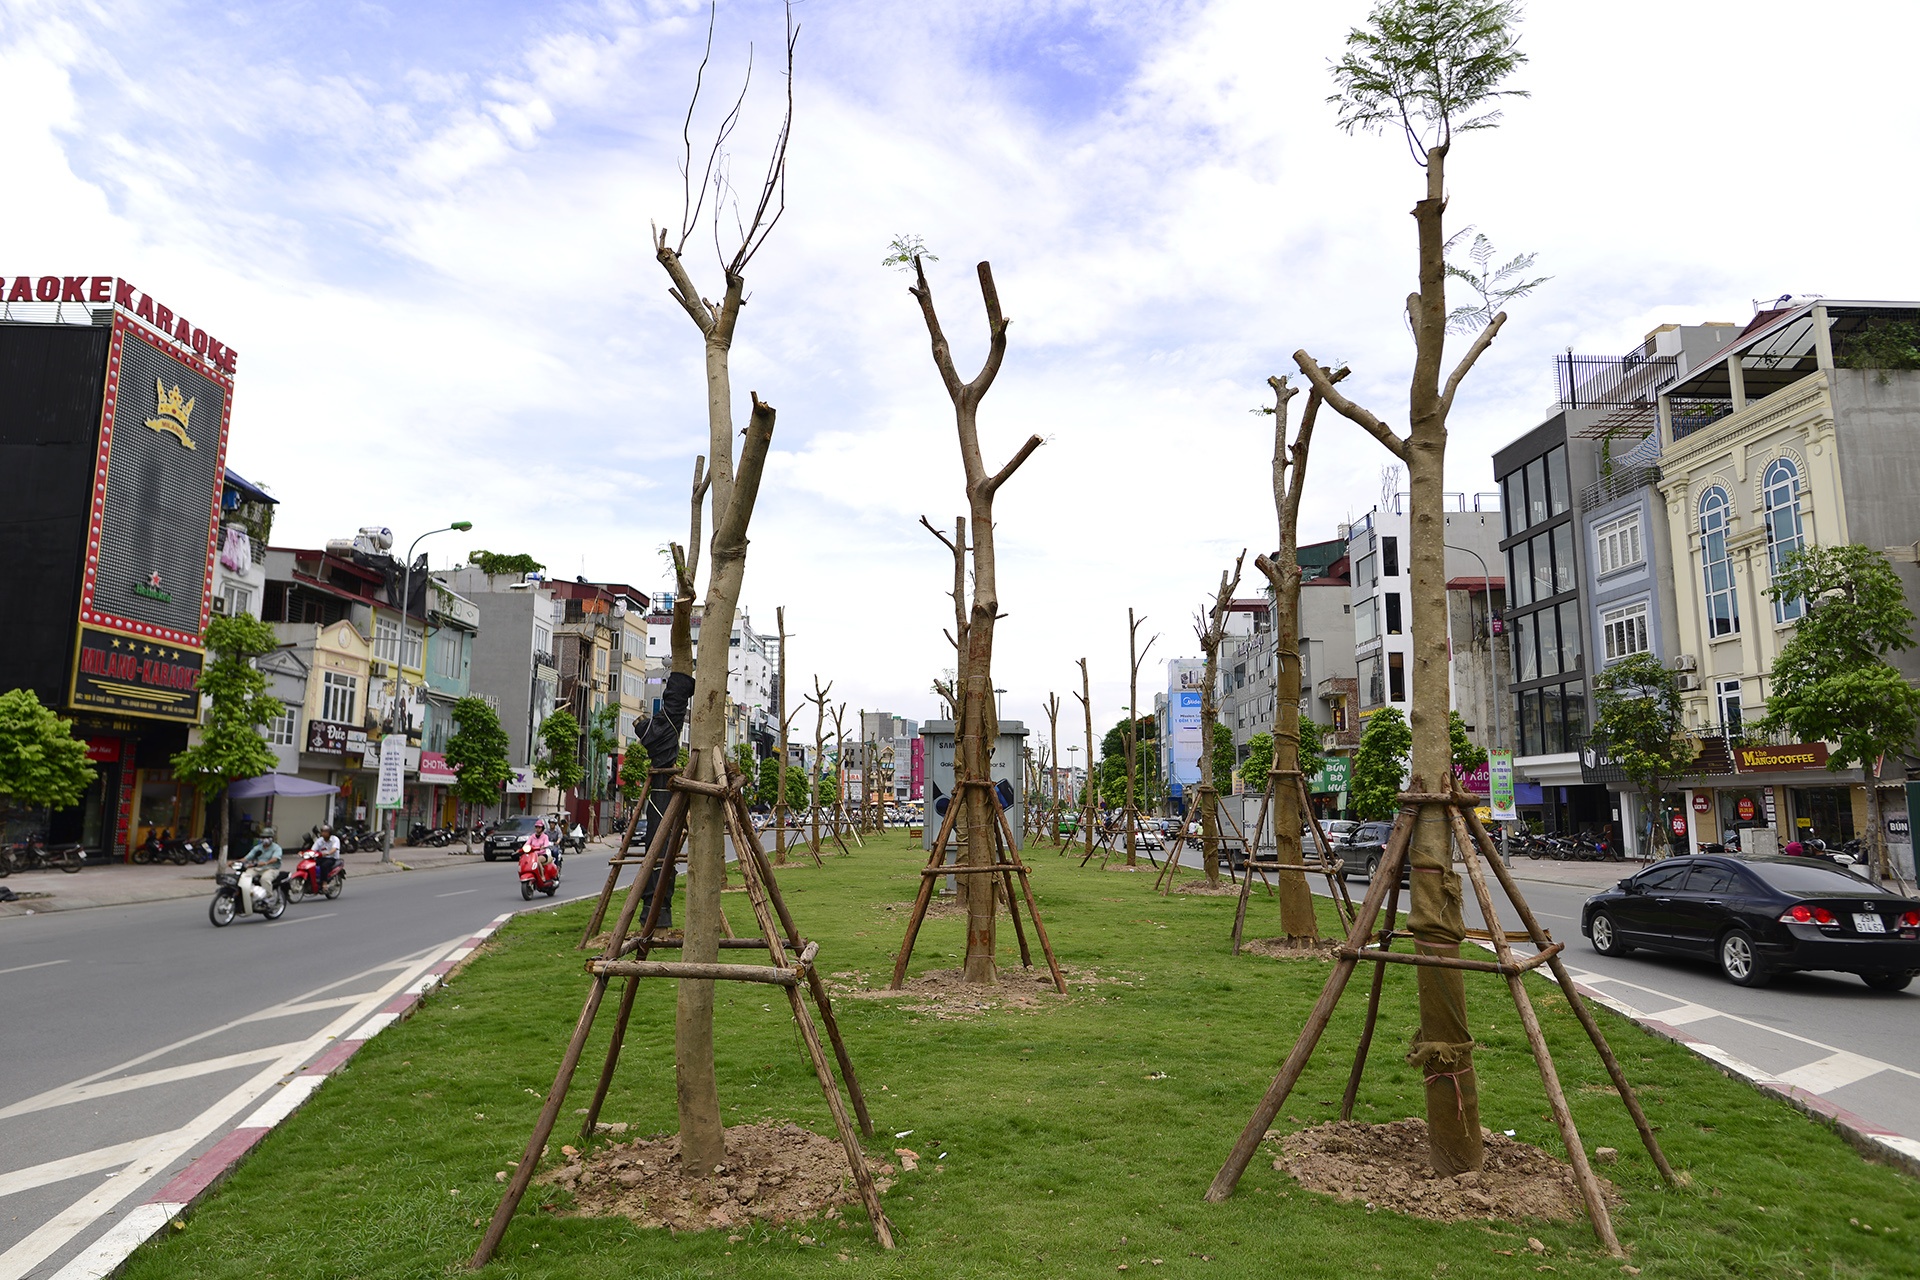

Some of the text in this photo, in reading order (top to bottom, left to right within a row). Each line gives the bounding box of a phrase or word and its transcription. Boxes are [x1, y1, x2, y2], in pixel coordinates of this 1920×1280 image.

[0, 276, 112, 302] AOKE
[114, 277, 238, 374] KARAOKE
[1326, 762, 1347, 772] BÚN
[1330, 772, 1344, 782] BÒ
[1470, 769, 1489, 780] Xác
[1889, 821, 1908, 831] BÚN
